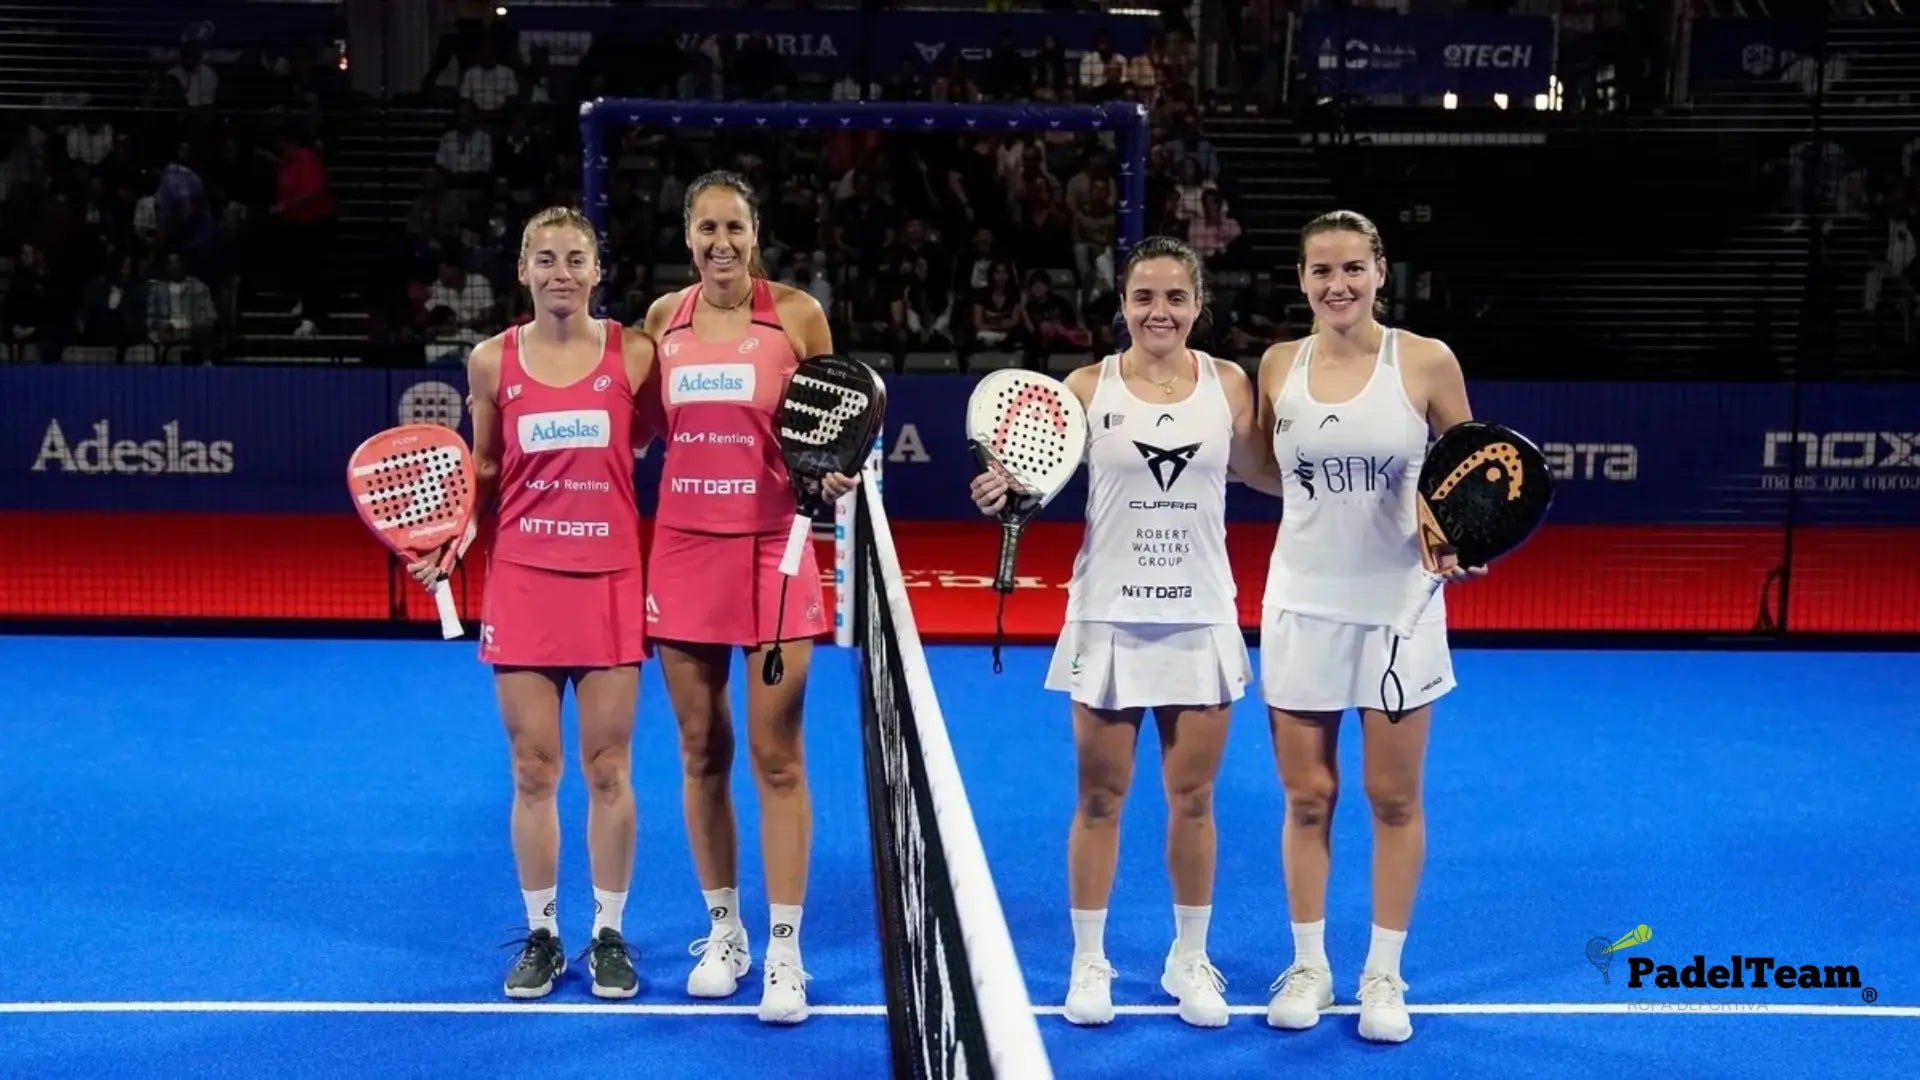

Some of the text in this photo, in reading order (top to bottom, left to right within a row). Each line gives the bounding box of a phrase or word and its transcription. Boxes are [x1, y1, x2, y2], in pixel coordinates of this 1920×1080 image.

[677, 371, 744, 393] Adeslas
[530, 418, 600, 442] Adeslas
[31, 418, 234, 474] Adeslas
[708, 432, 755, 447] Renting
[564, 478, 609, 493] Renting
[671, 477, 702, 495] NTT
[1762, 475, 1816, 489] maes
[1128, 500, 1198, 511] CUPRA
[519, 517, 555, 535] NTT
[1136, 528, 1189, 540] ROBERT
[1132, 542, 1190, 554] WALTERS
[1138, 555, 1183, 567] GROUP
[1121, 585, 1154, 599] NTT
